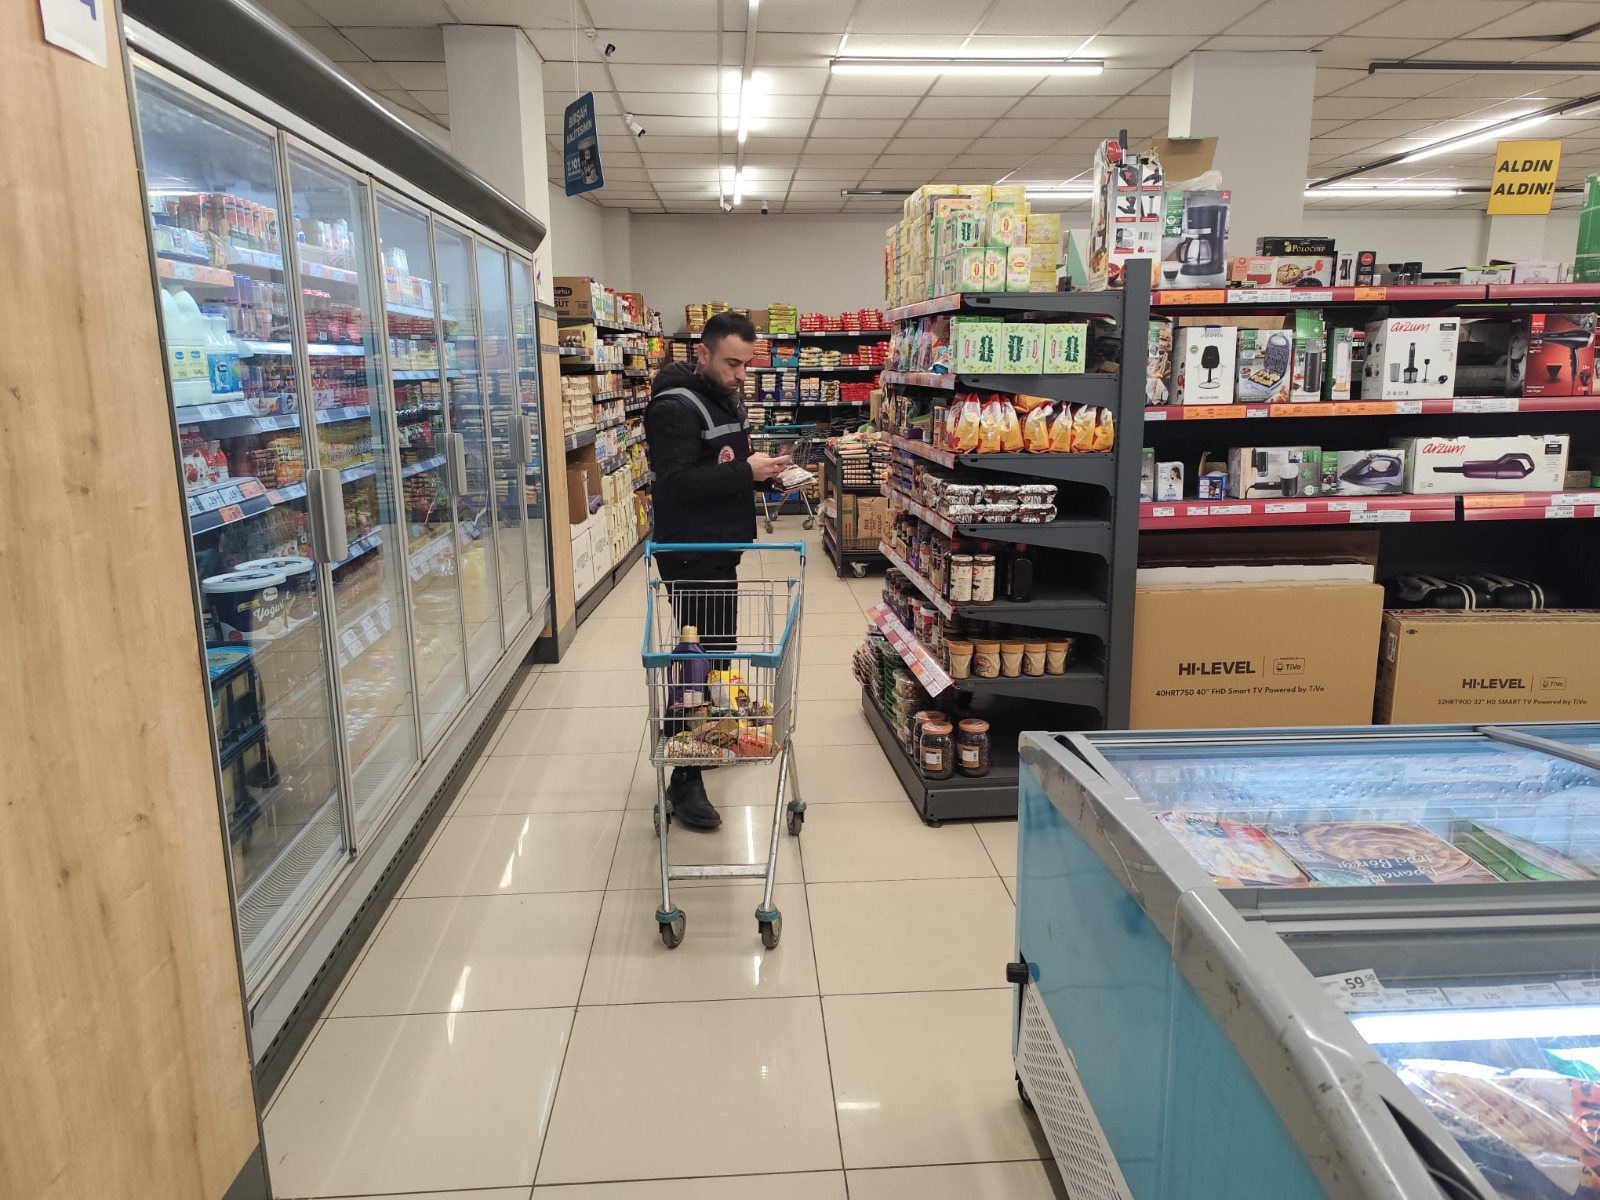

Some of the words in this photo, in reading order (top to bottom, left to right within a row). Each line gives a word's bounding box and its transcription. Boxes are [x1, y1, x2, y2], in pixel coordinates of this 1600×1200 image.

[1497, 159, 1554, 173] ALDIN
[1493, 182, 1554, 196] ALDIN!
[1390, 321, 1431, 334] arzum
[1422, 442, 1467, 455] arzum
[1285, 663, 1302, 671] TiVo
[1155, 689, 1194, 697] 40HRT750
[1228, 687, 1250, 695] Smart
[1265, 686, 1296, 694] Powered
[1297, 685, 1307, 694] by
[1563, 698, 1571, 706] by
